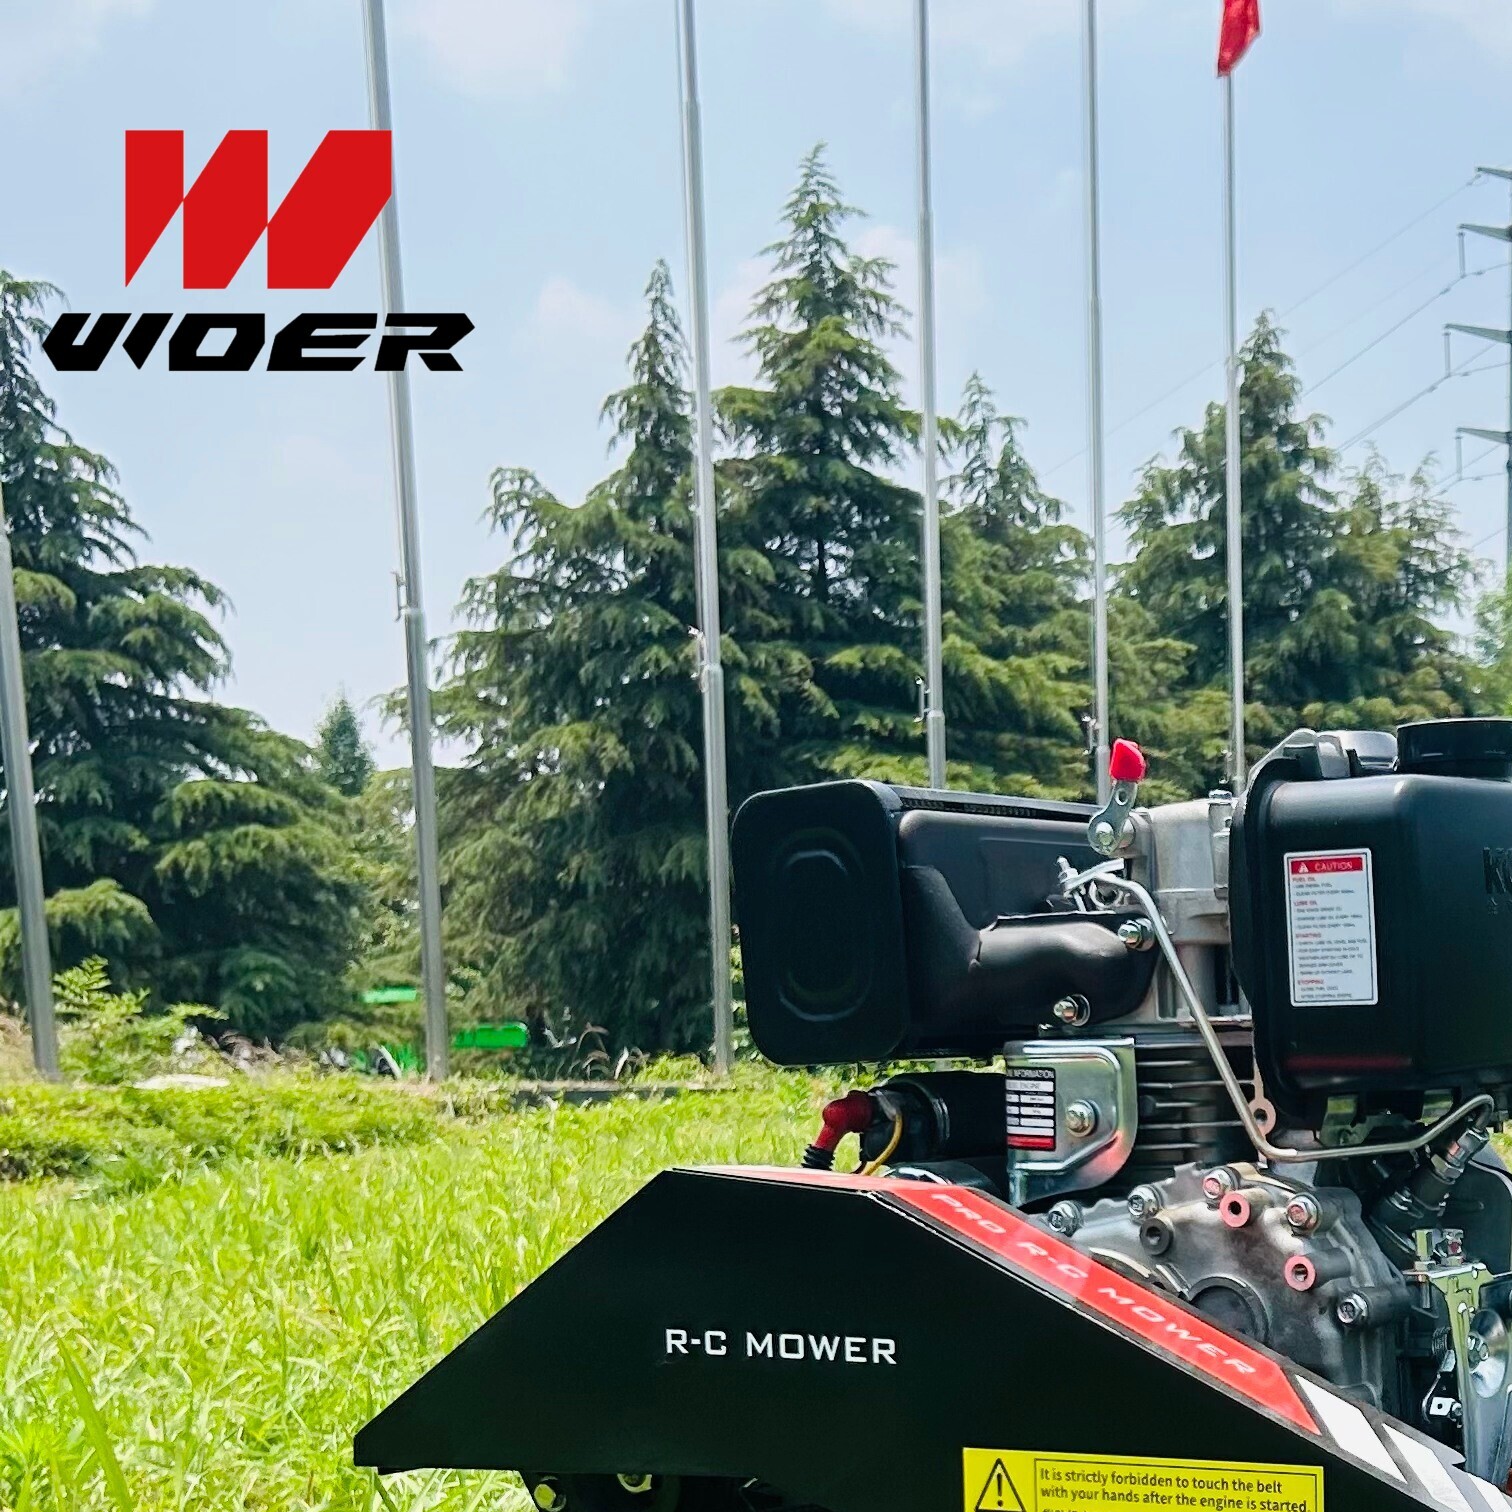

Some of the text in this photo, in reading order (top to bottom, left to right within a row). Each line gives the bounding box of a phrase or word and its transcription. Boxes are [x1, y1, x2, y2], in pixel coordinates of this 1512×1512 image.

[1314, 861, 1353, 872] CAUTION
[930, 1193, 1006, 1235] PRO
[1096, 1286, 1258, 1374] MOWER
[665, 1328, 897, 1365] R-C MOWER
[1041, 1467, 1282, 1494] It is strictly forbidden to touch the belt
[1041, 1486, 1068, 1498] with
[1071, 1490, 1099, 1502] your
[1102, 1490, 1139, 1503] hands
[1143, 1491, 1173, 1505] after
[1176, 1493, 1197, 1506] the
[1200, 1495, 1243, 1511] engine
[1246, 1496, 1257, 1510] is
